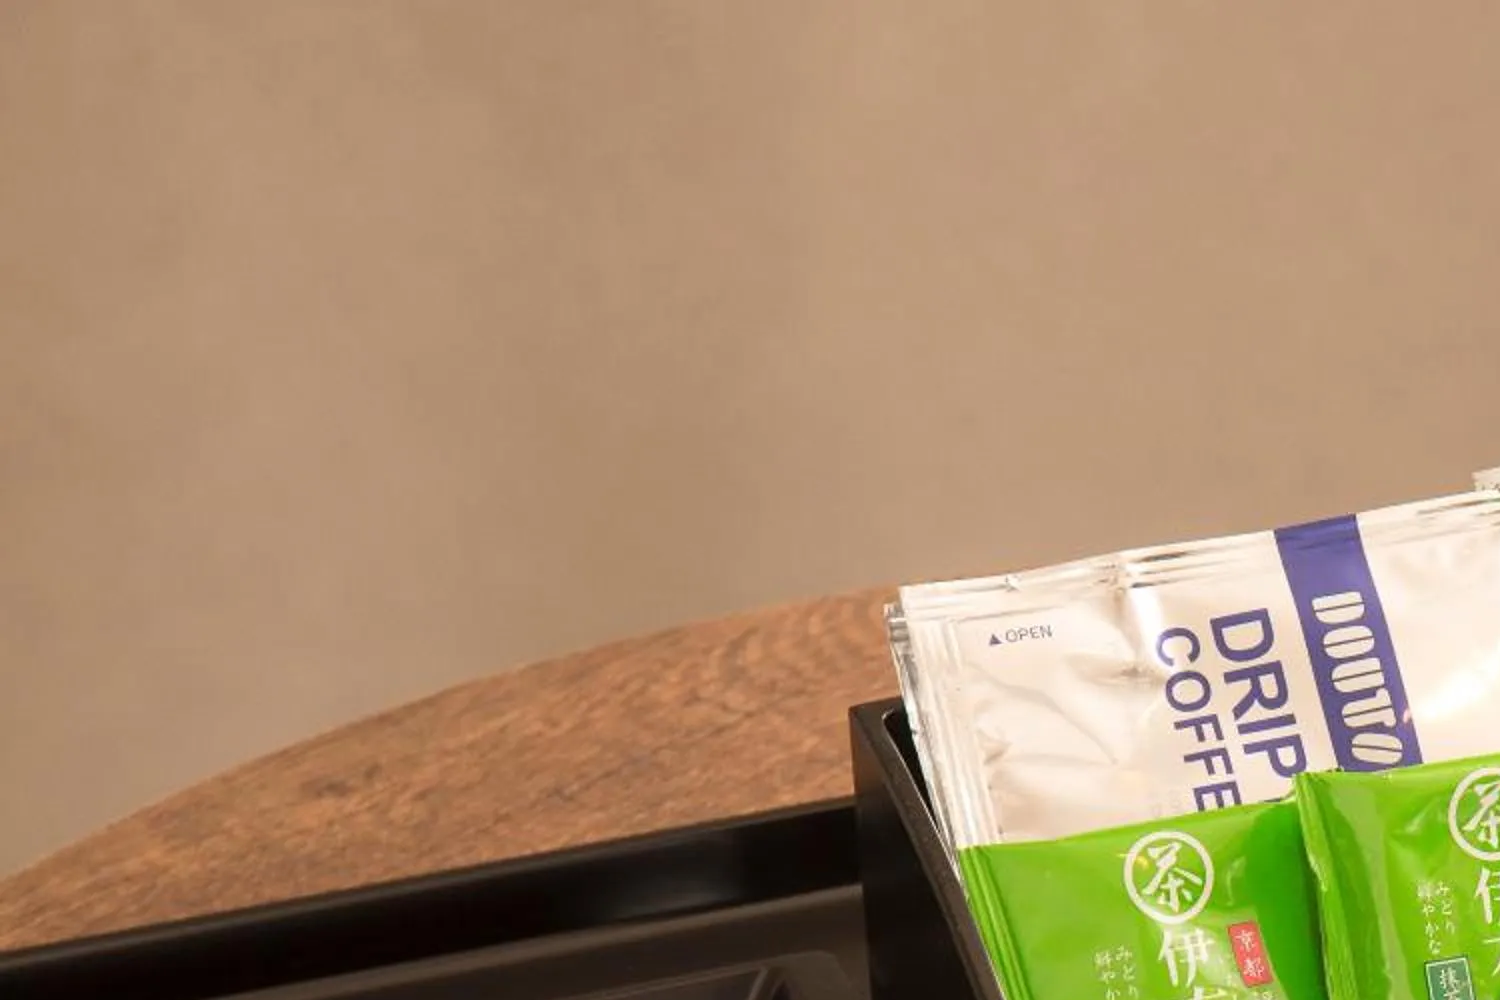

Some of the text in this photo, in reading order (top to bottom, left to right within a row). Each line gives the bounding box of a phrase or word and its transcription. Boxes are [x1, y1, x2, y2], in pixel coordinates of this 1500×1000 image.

[1005, 625, 1052, 643] OPEN
[1155, 627, 1242, 811] COFFE
[1209, 608, 1307, 778] DRIP
[1236, 930, 1264, 977] 京都
